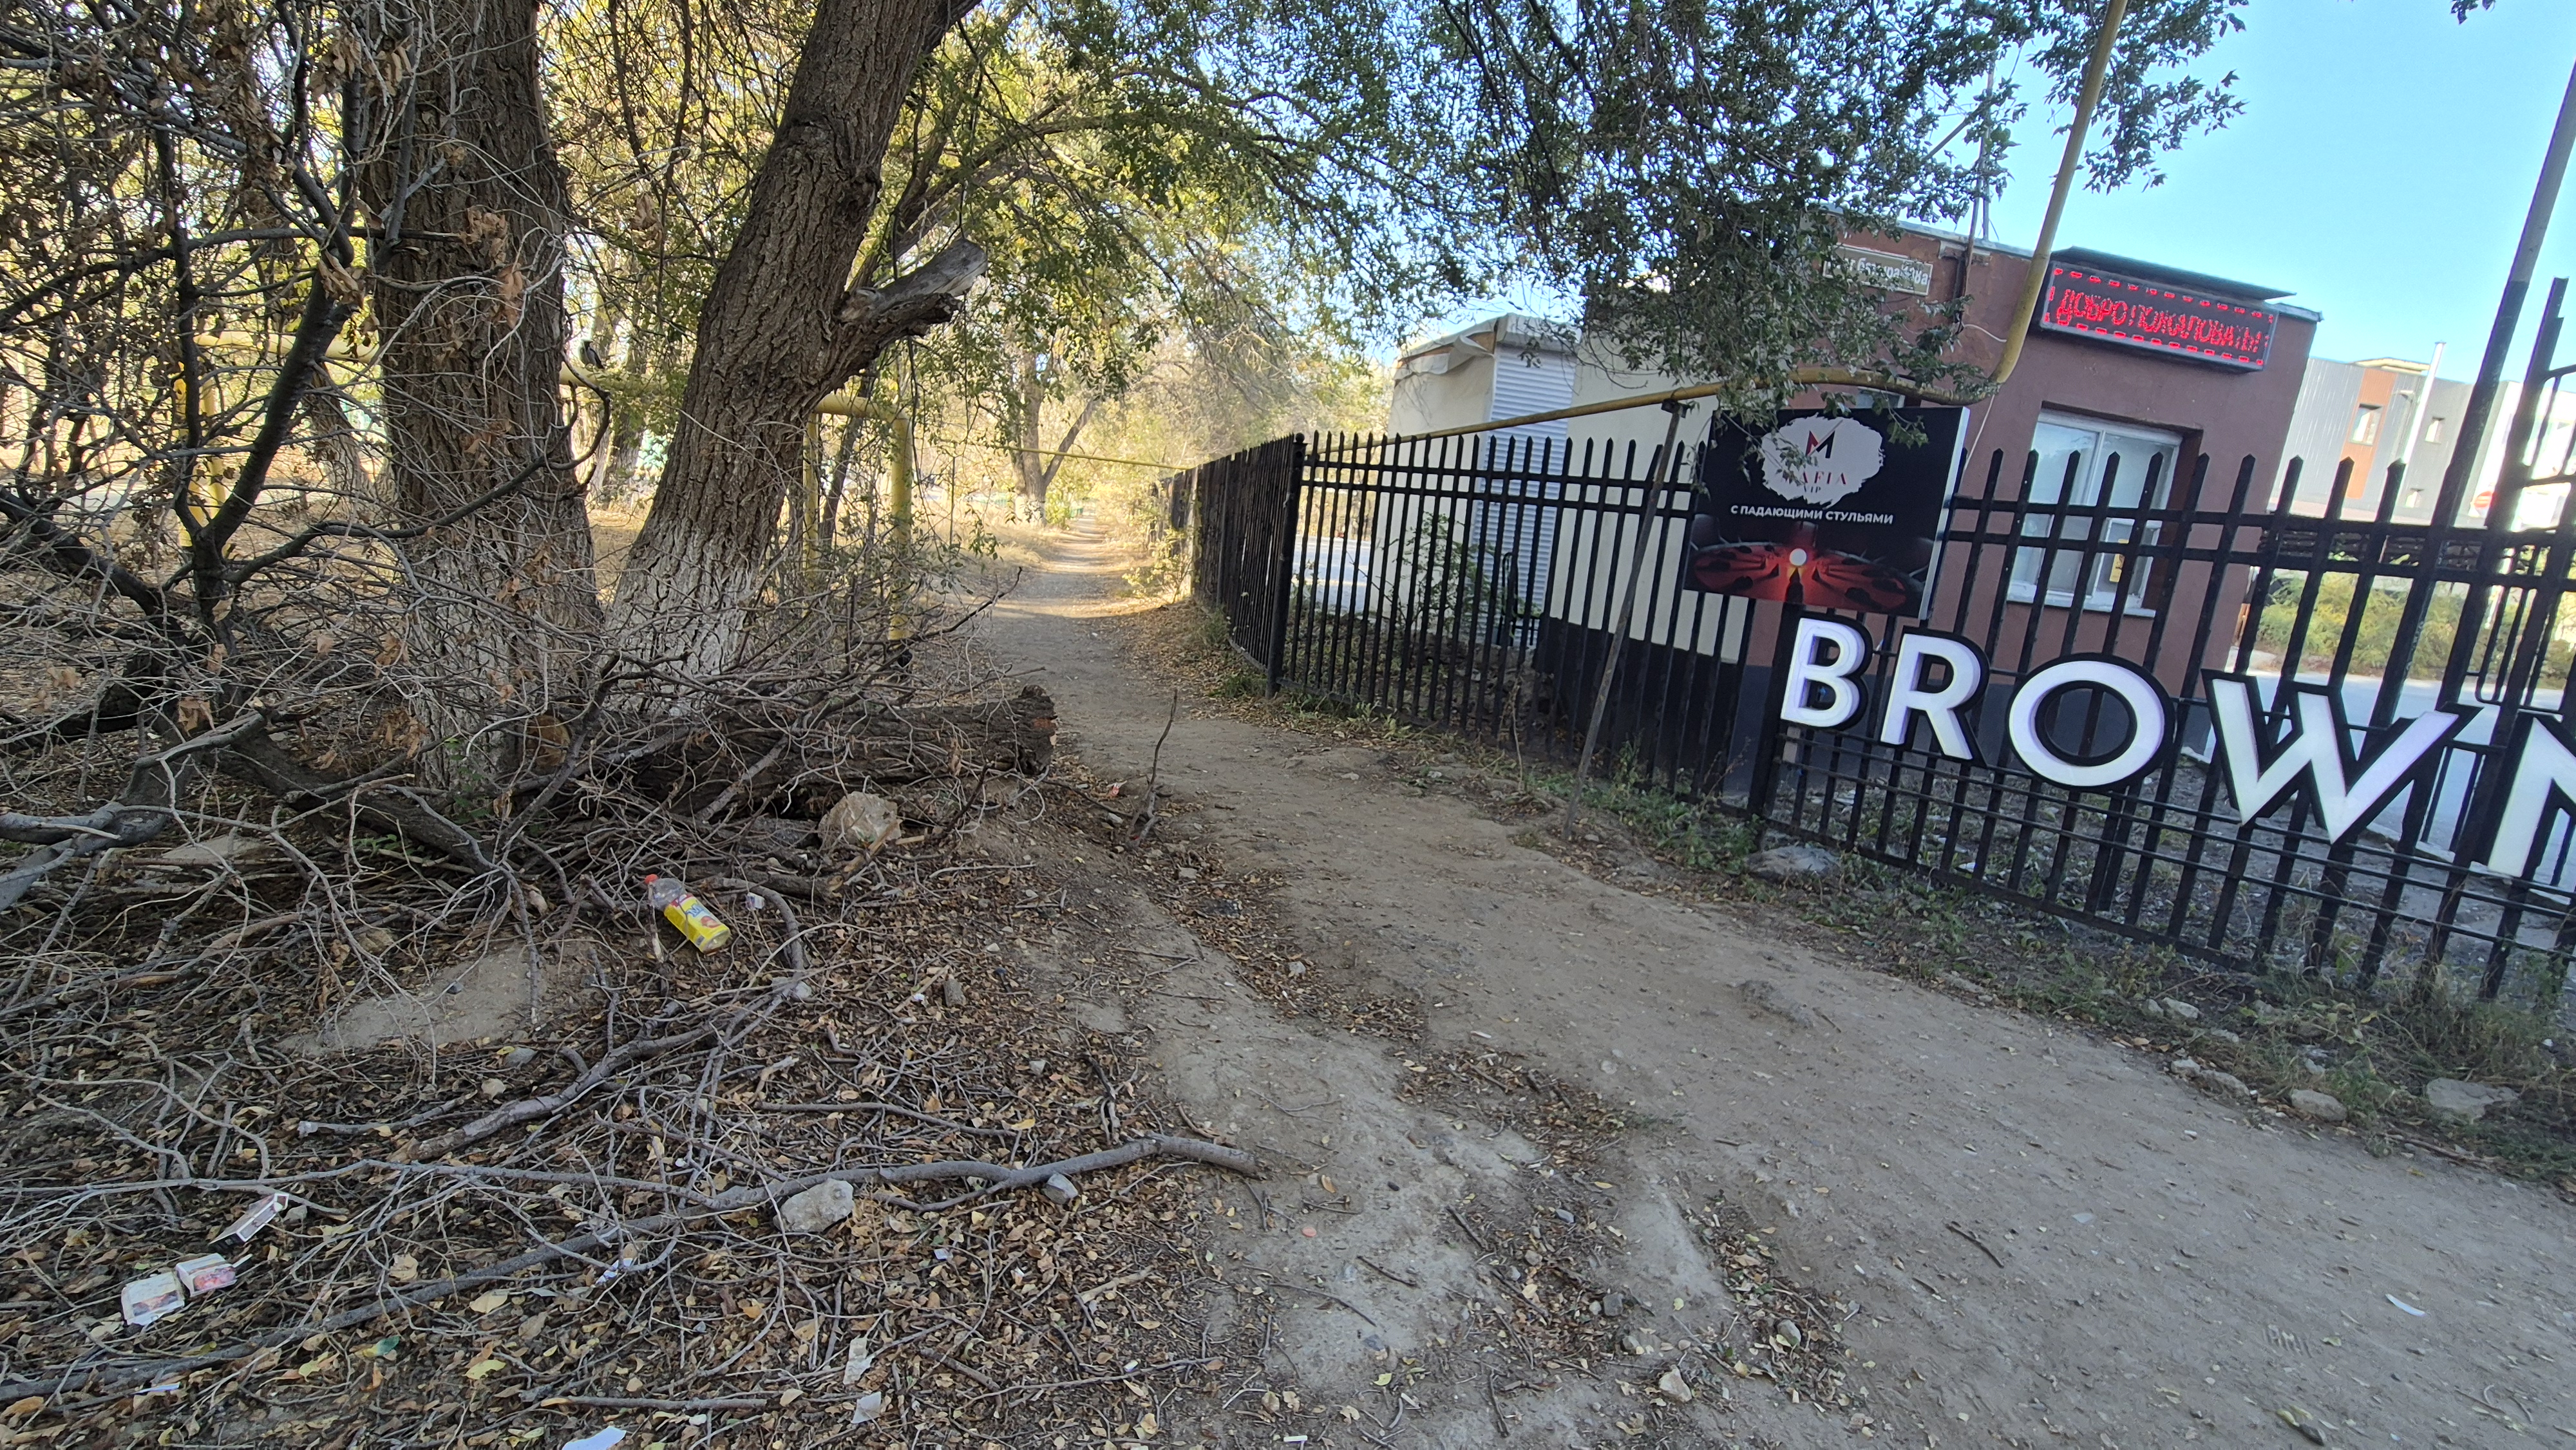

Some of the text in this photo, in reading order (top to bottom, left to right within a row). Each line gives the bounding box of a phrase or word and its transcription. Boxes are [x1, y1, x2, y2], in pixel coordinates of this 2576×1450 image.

[1730, 505, 1893, 525] С ПАДАЮЩИМИ СТУЛЬЯМИ
